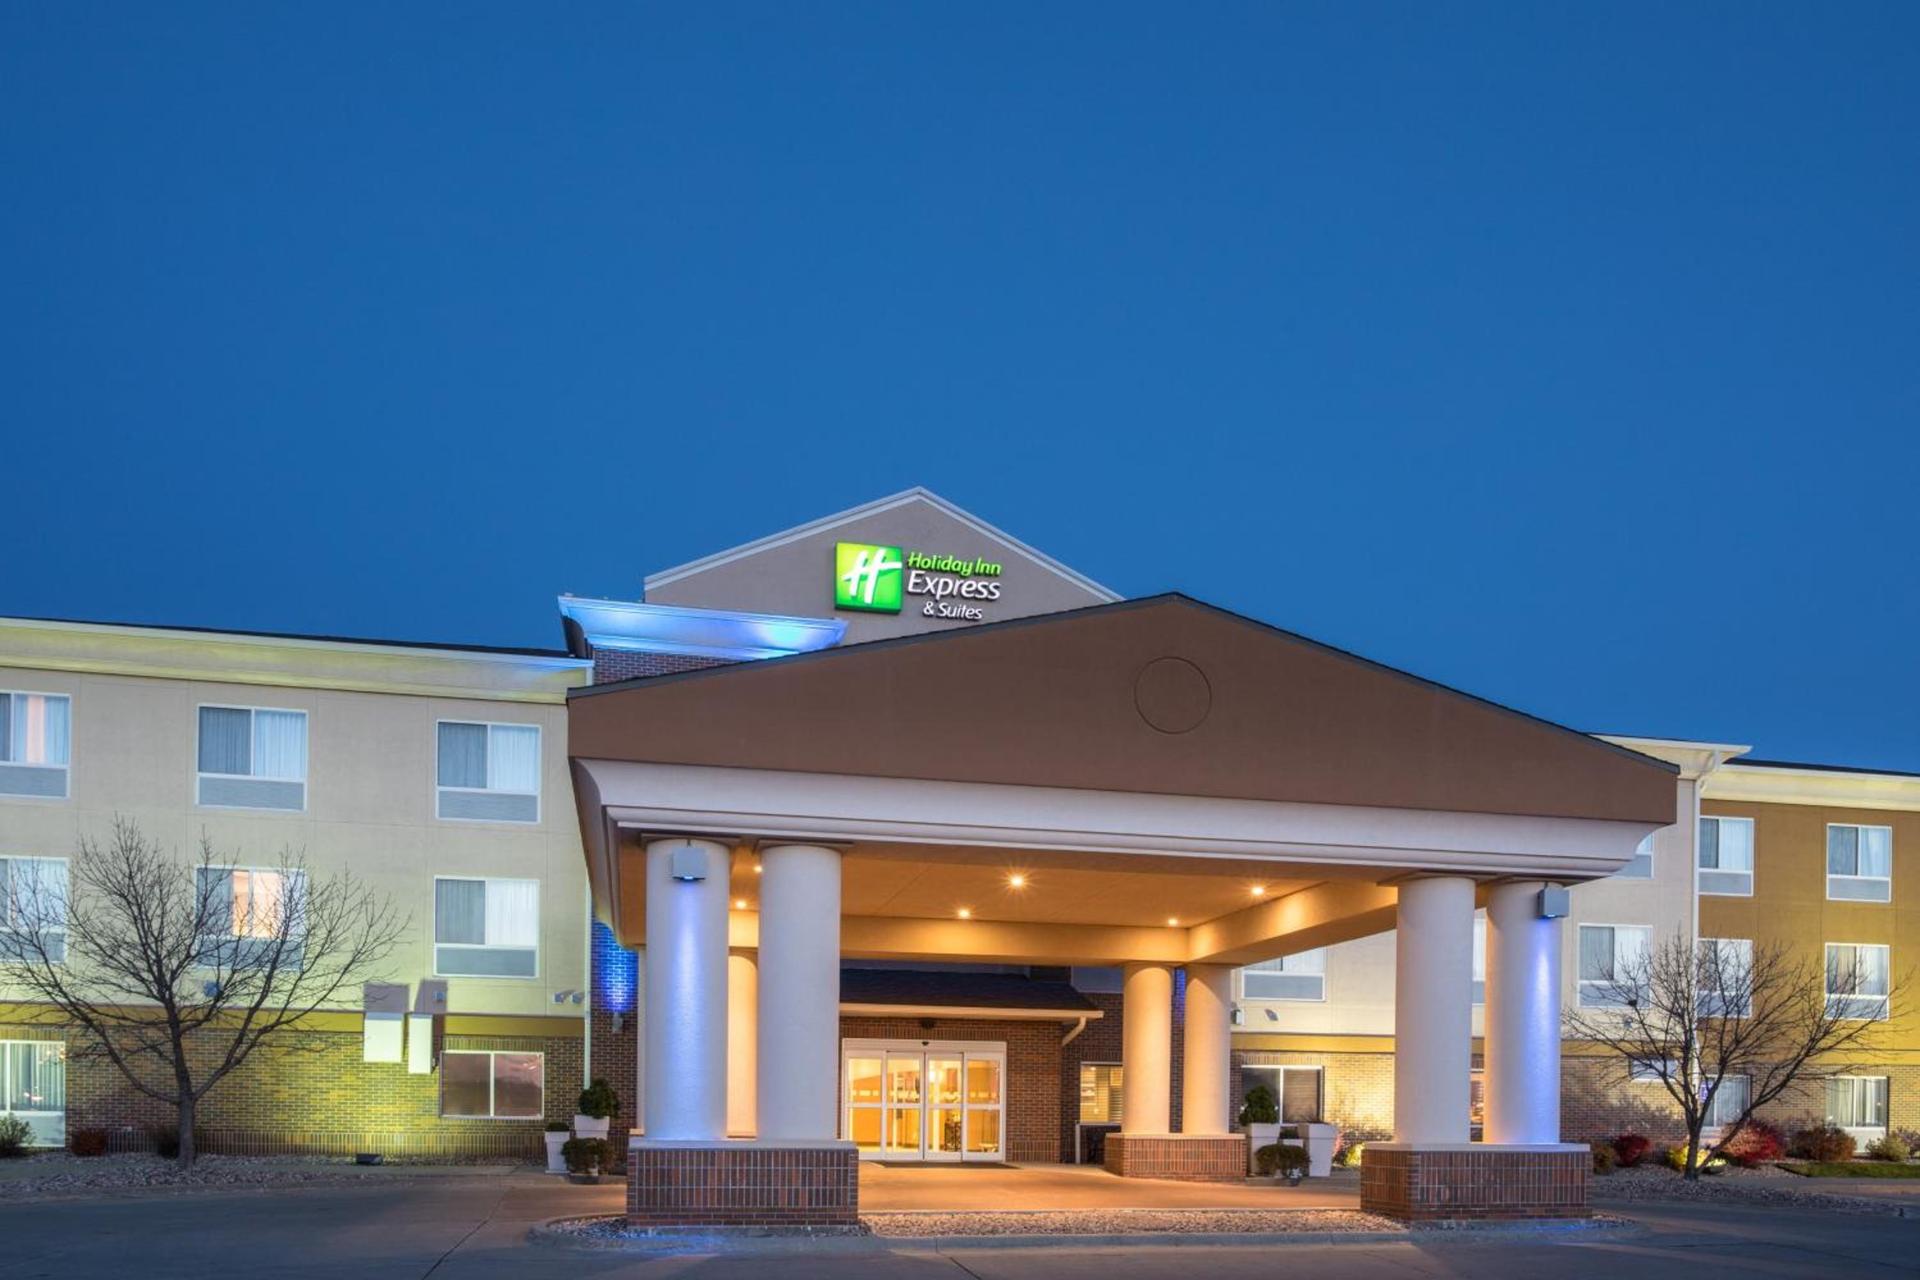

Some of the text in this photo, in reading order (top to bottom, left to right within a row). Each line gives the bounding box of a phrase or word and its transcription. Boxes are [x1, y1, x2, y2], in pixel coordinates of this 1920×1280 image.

[908, 552, 1001, 577] Holiday Inn
[907, 570, 1001, 601] Express
[923, 601, 983, 620] & Suites
